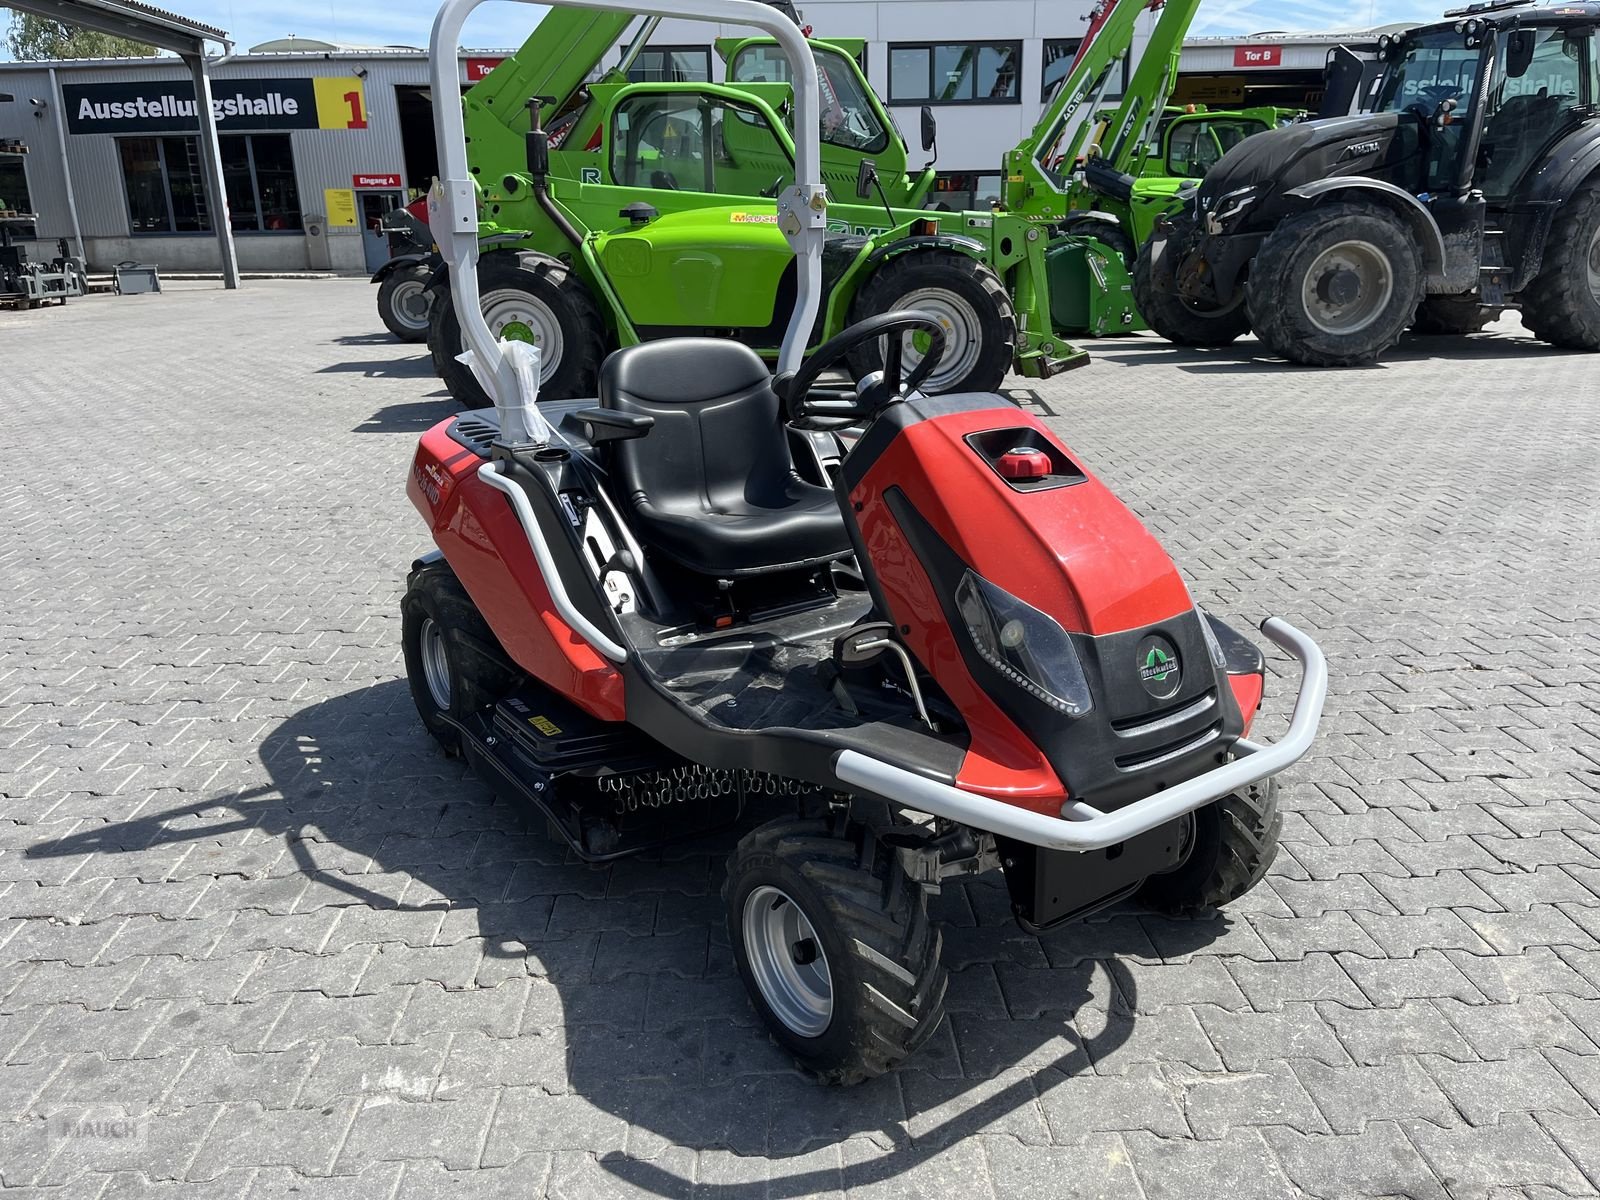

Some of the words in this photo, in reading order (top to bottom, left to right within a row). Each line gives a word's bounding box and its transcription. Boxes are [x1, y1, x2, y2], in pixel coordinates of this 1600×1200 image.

[1245, 51, 1261, 60] Tor
[1263, 50, 1271, 60] B
[343, 91, 368, 129] 1
[1063, 91, 1084, 121] 40.16
[359, 177, 387, 186] Eingang
[388, 177, 395, 185] A
[735, 214, 777, 223] MAUCH
